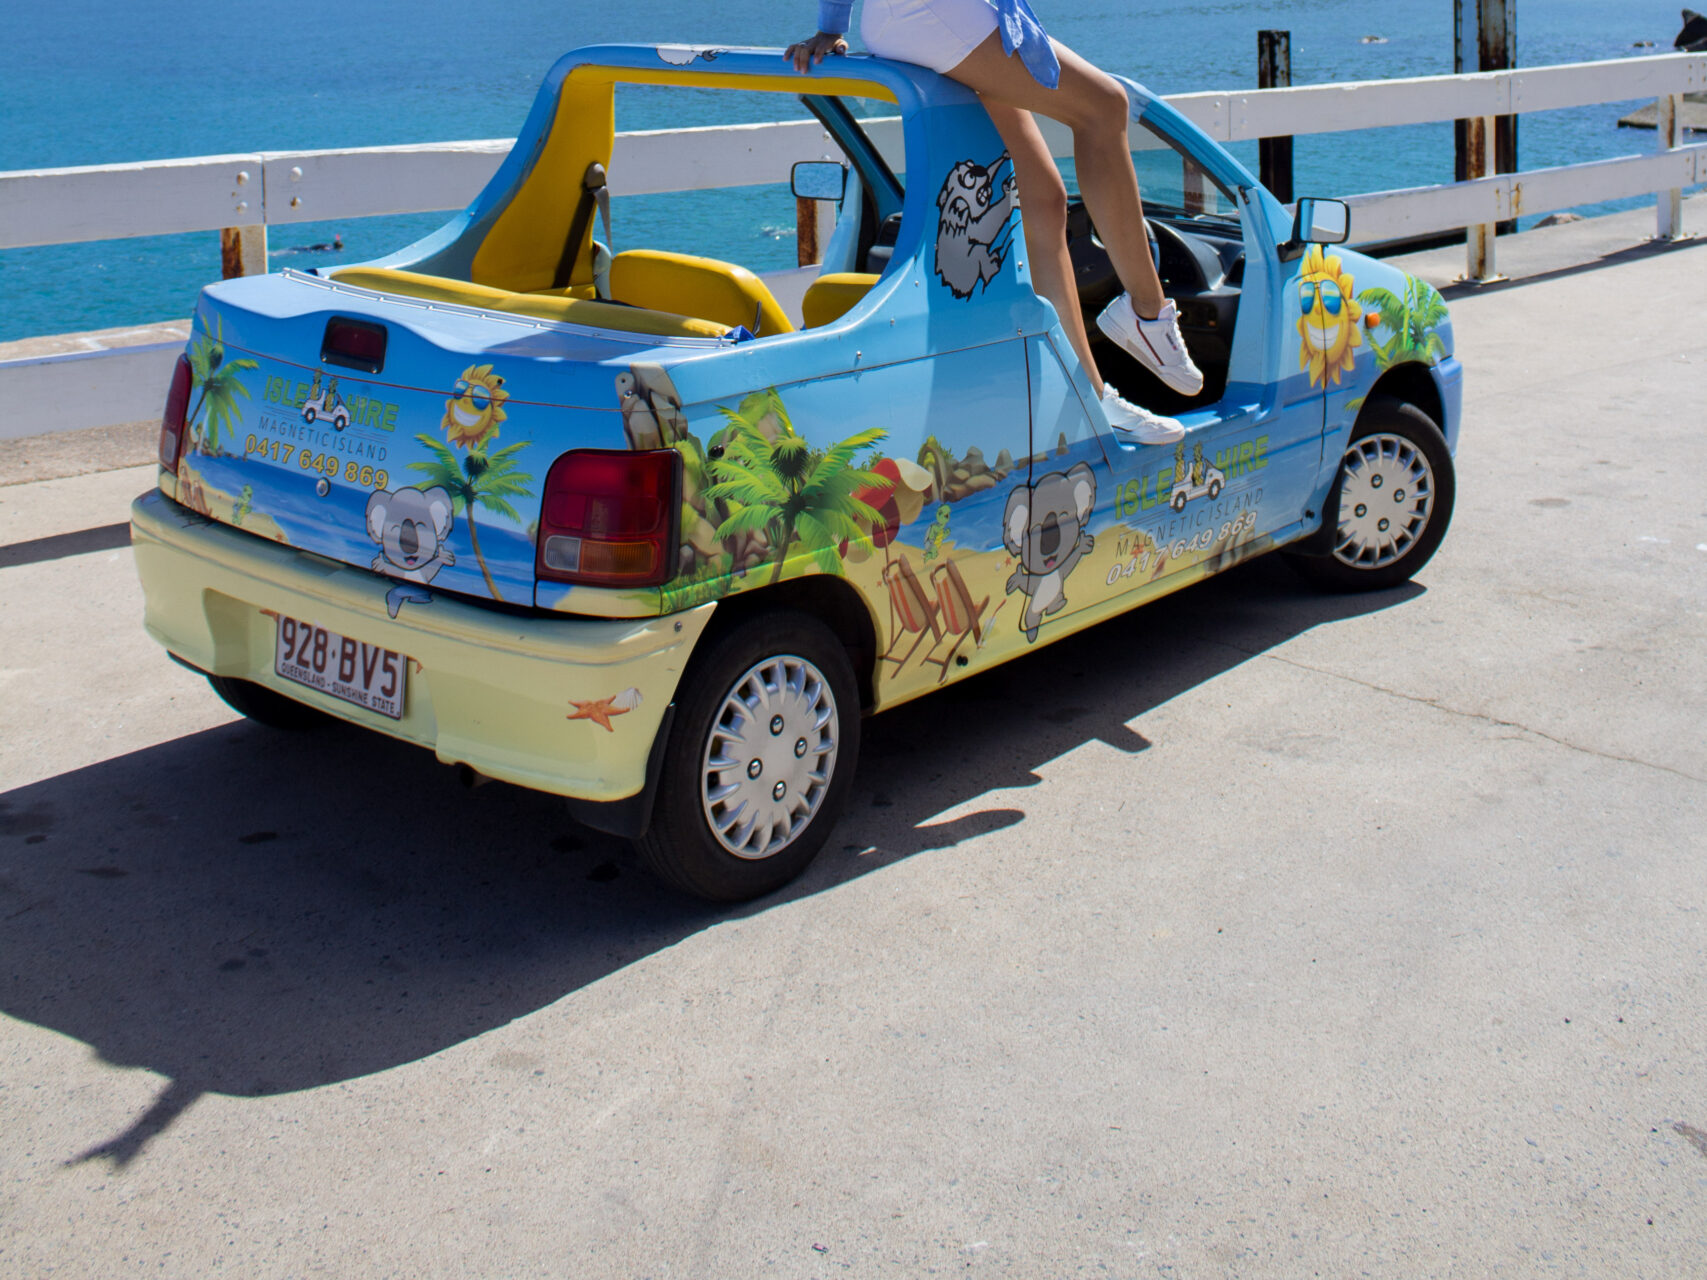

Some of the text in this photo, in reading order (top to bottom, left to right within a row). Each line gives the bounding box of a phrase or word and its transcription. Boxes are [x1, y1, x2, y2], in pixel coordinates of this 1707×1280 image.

[264, 375, 400, 432] ISLE HIRE
[245, 433, 389, 490] 0417 649 869
[258, 415, 388, 461] MAGNETIC ISLAND
[1114, 434, 1269, 520] ISLE HIRE
[1106, 511, 1258, 585] 0417 649 869
[1115, 487, 1264, 559] MAGNETIC ISLAND
[281, 662, 326, 688] QUEENSLAND
[332, 681, 369, 704] SUNSHINE
[371, 695, 395, 714] STATE
